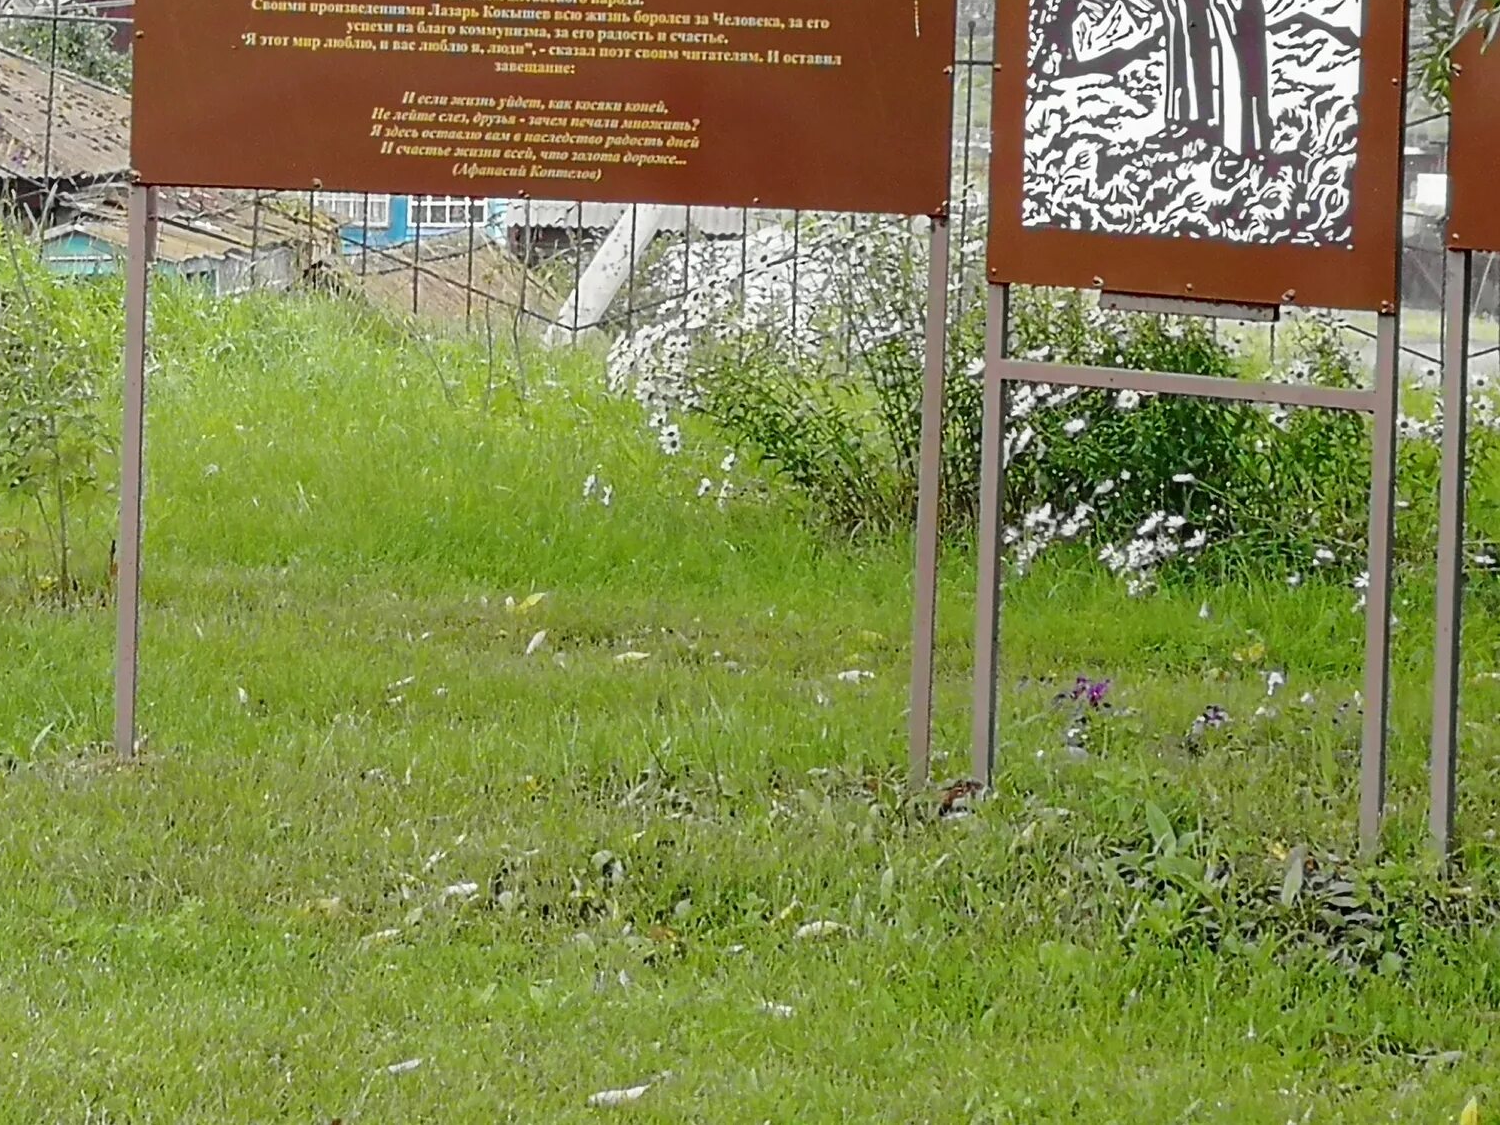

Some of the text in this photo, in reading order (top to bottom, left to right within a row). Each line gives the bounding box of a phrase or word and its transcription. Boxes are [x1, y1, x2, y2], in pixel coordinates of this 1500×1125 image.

[310, 2, 425, 19] произведениями
[428, 2, 479, 21] Лазарь
[483, 4, 551, 20] Кокышев
[554, 10, 582, 21] всю
[585, 11, 630, 23] жизнь
[634, 9, 690, 28] боролся
[694, 15, 709, 25] за
[789, 18, 803, 29] за
[807, 19, 829, 30] его
[346, 21, 393, 36] успехи
[397, 23, 413, 33] на
[417, 20, 456, 35] благо
[554, 28, 569, 39] за
[572, 29, 594, 40] его
[598, 30, 654, 45] радость
[657, 32, 666, 42] и
[260, 35, 289, 47] этот
[293, 36, 321, 52] мир
[380, 39, 388, 51] и
[393, 40, 415, 51] вас
[419, 37, 468, 53] люблю
[549, 45, 595, 58] сказал
[600, 47, 632, 59] поэт
[635, 48, 678, 61] своим
[767, 49, 779, 64] И
[783, 53, 841, 66] оставил
[494, 61, 575, 77] завещание:
